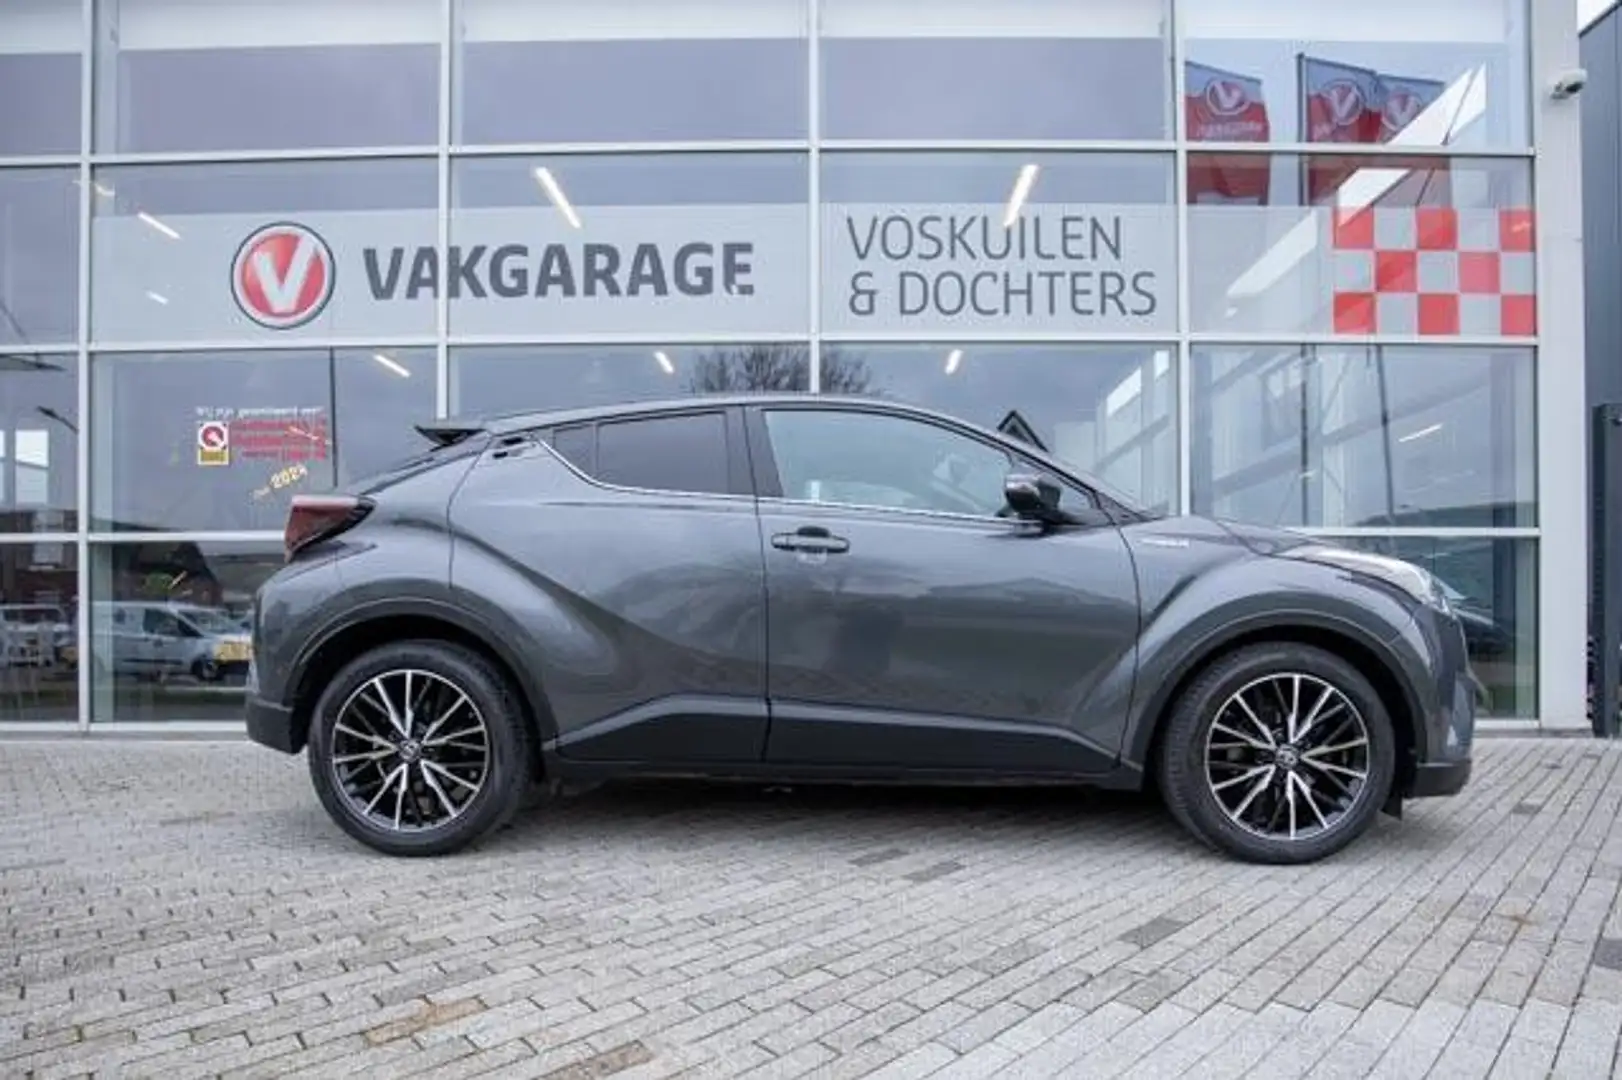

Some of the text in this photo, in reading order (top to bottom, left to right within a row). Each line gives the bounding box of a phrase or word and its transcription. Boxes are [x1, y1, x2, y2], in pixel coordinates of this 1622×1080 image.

[847, 215, 1121, 261] VOSKUILEN
[363, 242, 755, 301] VAKGARAGE
[849, 270, 1157, 317] & DOCHTERS
